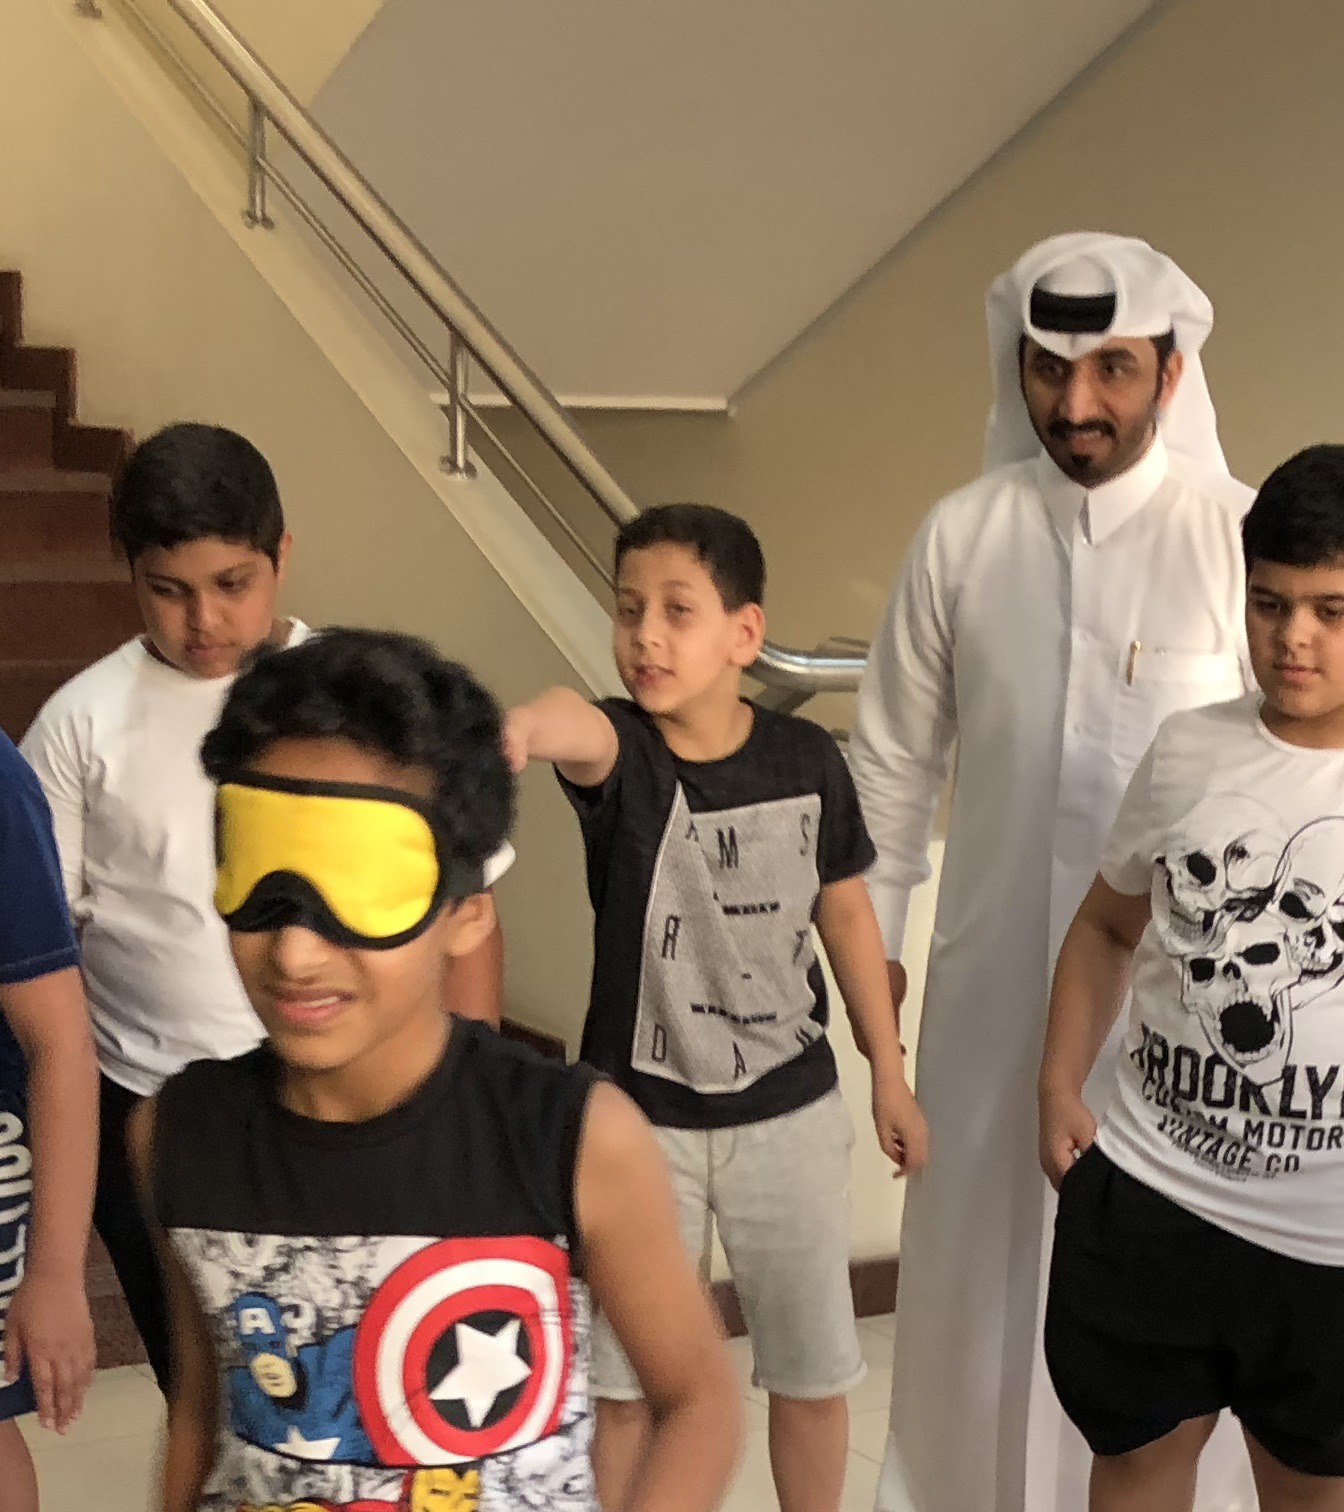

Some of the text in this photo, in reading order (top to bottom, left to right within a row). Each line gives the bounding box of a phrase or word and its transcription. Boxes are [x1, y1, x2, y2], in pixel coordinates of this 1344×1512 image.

[717, 825, 739, 869] M
[799, 813, 811, 857] S
[651, 1023, 746, 1079] D A
[1242, 1118, 1344, 1151] MOTOR
[239, 1307, 277, 1335] A
